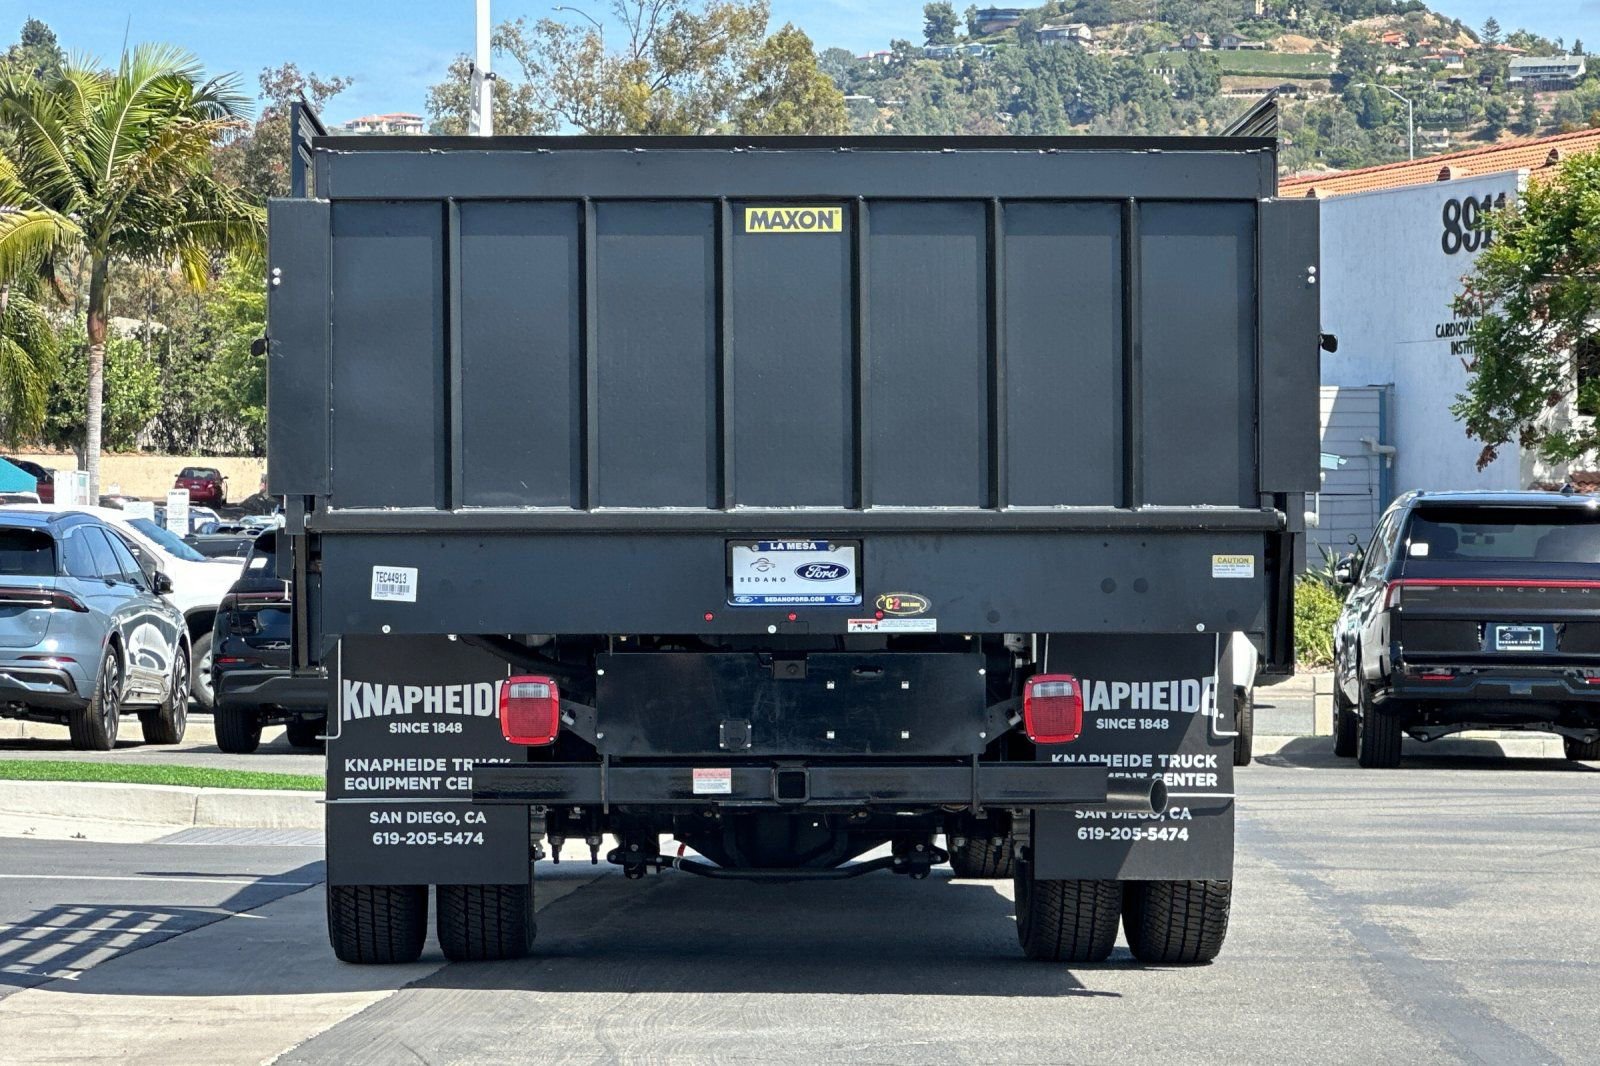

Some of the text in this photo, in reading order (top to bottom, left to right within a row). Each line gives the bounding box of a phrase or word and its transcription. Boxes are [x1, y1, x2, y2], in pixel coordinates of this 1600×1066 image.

[749, 210, 834, 230] MAXON
[770, 542, 817, 550] LA MESA
[805, 565, 839, 578] Ford
[1452, 586, 1591, 594] LINCOLN
[885, 597, 900, 610] C2
[1082, 675, 1218, 717] APHEIDE
[389, 722, 463, 734] SINCE 1848
[1096, 718, 1170, 730] SINCE 1848
[344, 758, 447, 772] KNAPHEIDE
[1158, 754, 1218, 769] TRUCK
[344, 777, 442, 791] EQUIPMENT
[369, 811, 487, 826] SAN DIEGO, CA
[1169, 806, 1193, 820] CA
[372, 832, 485, 846] 619-205-5474
[1077, 826, 1190, 841] 619-205-5474
